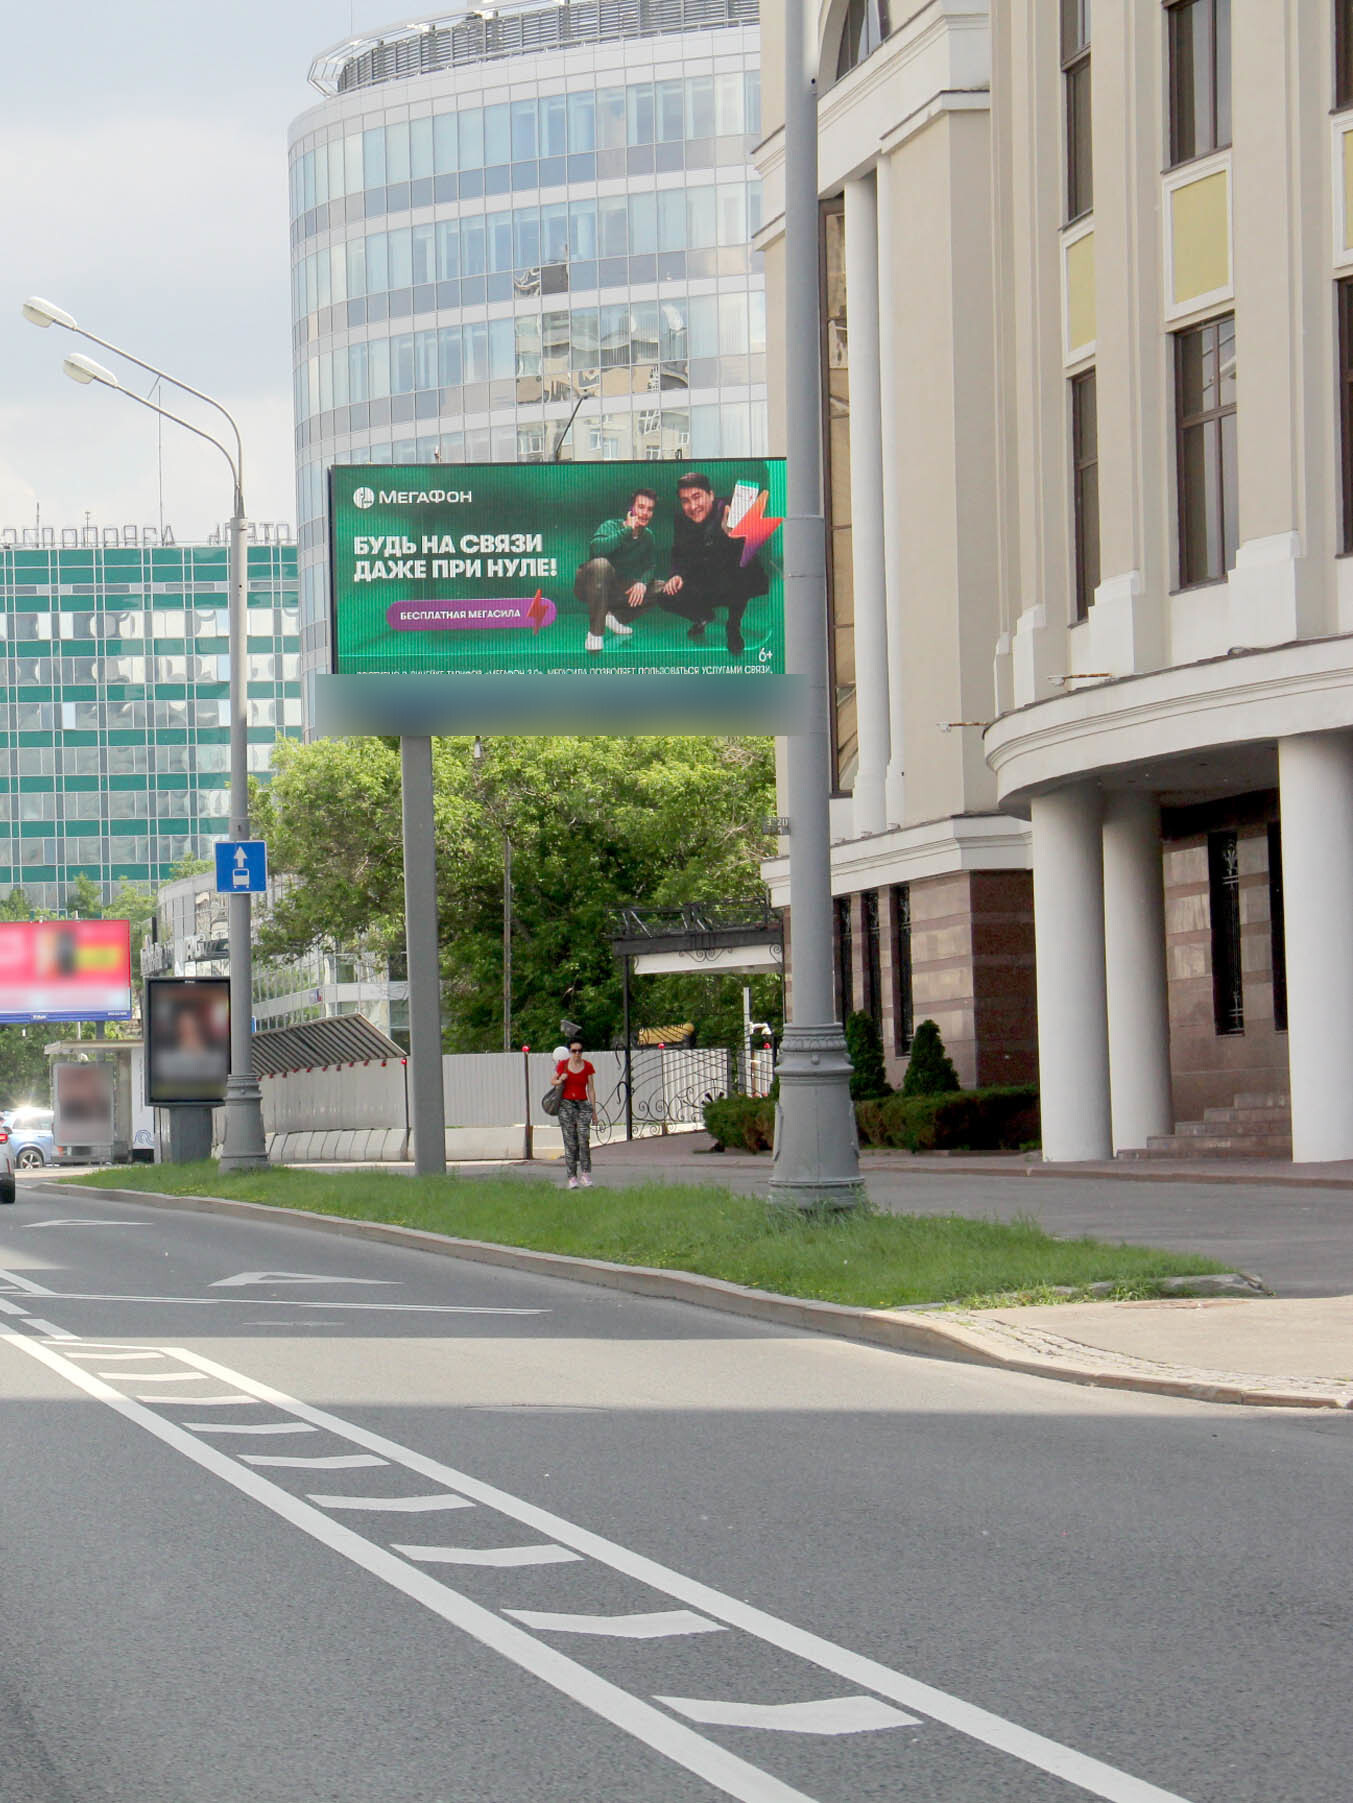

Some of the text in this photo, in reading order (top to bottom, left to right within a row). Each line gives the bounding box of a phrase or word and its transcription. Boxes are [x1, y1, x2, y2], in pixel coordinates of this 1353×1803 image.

[354, 533, 543, 557] БУДЬ НА СВЯЗИ
[354, 558, 558, 582] ДАЖЕ ПРИ НУЛЕ!
[400, 609, 521, 620] БЕСПЛАТНАЯ МЕГАСИЛА
[758, 647, 773, 662] 6+
[701, 665, 743, 674] УСЛУГАМИ
